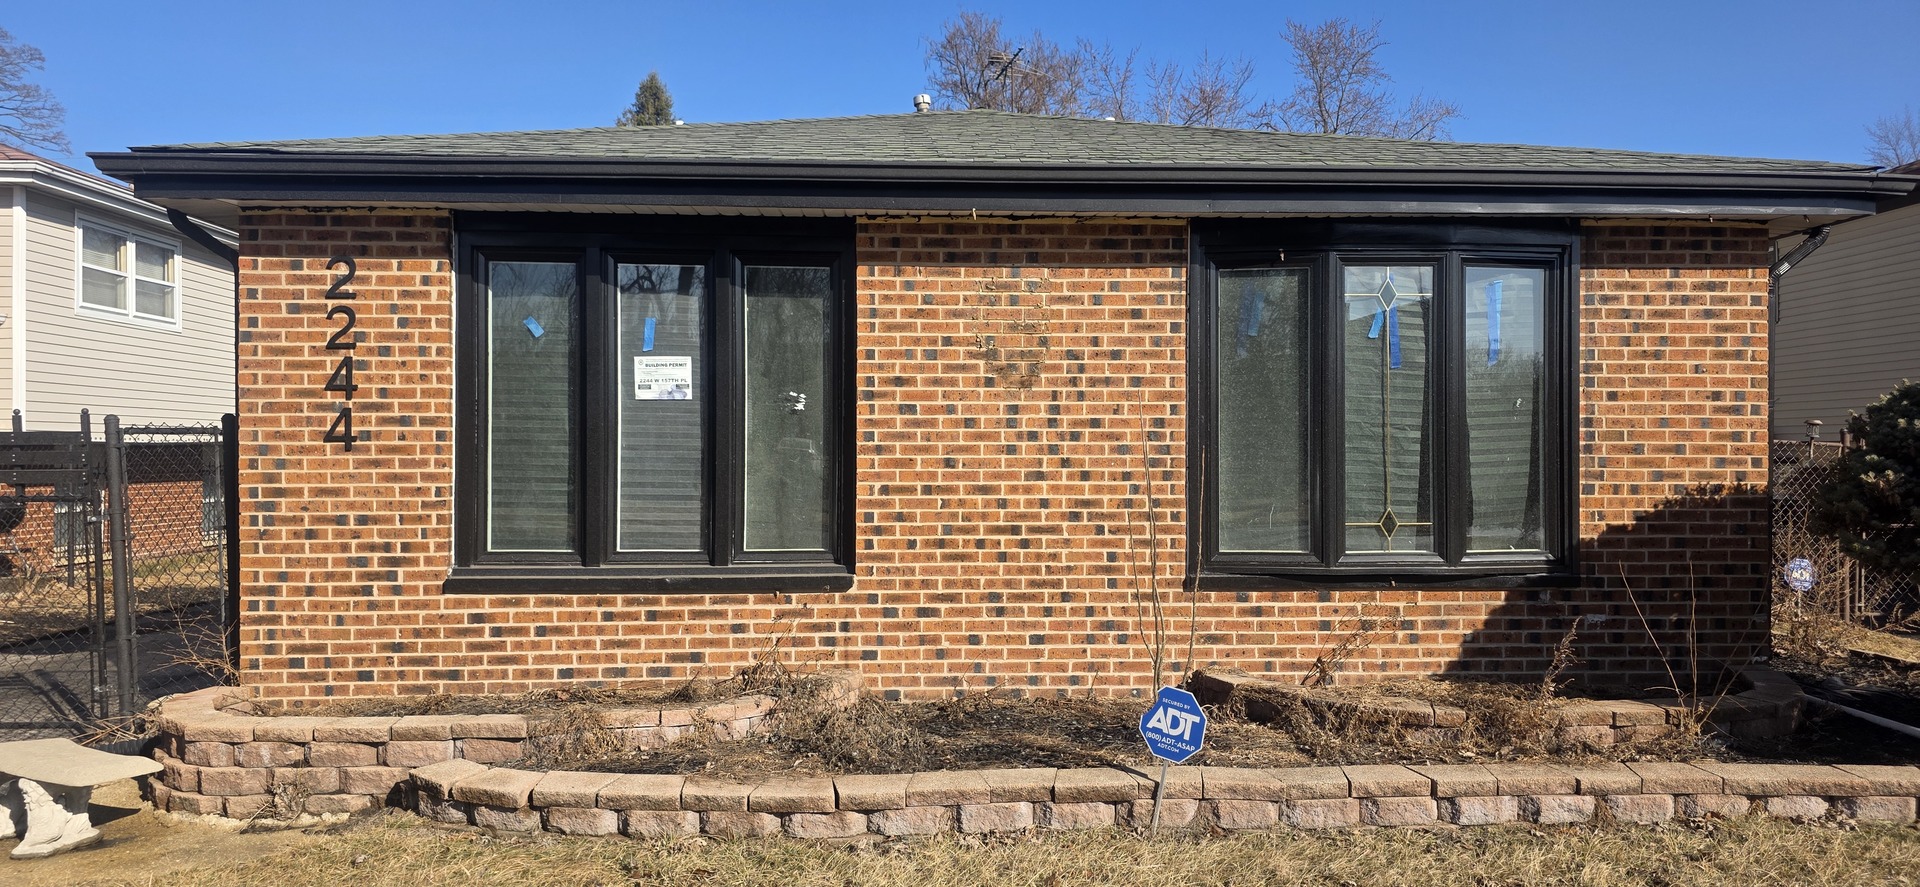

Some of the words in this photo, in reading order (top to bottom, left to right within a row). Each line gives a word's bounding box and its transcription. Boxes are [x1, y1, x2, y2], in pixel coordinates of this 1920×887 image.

[323, 256, 358, 452] 2244
[1162, 698, 1183, 708] SECURED
[1146, 706, 1200, 740] ADT
[1146, 731, 1162, 742] (800)
[1162, 736, 1196, 752] ADT-ASAP
[1157, 743, 1180, 753] ADT.COM
